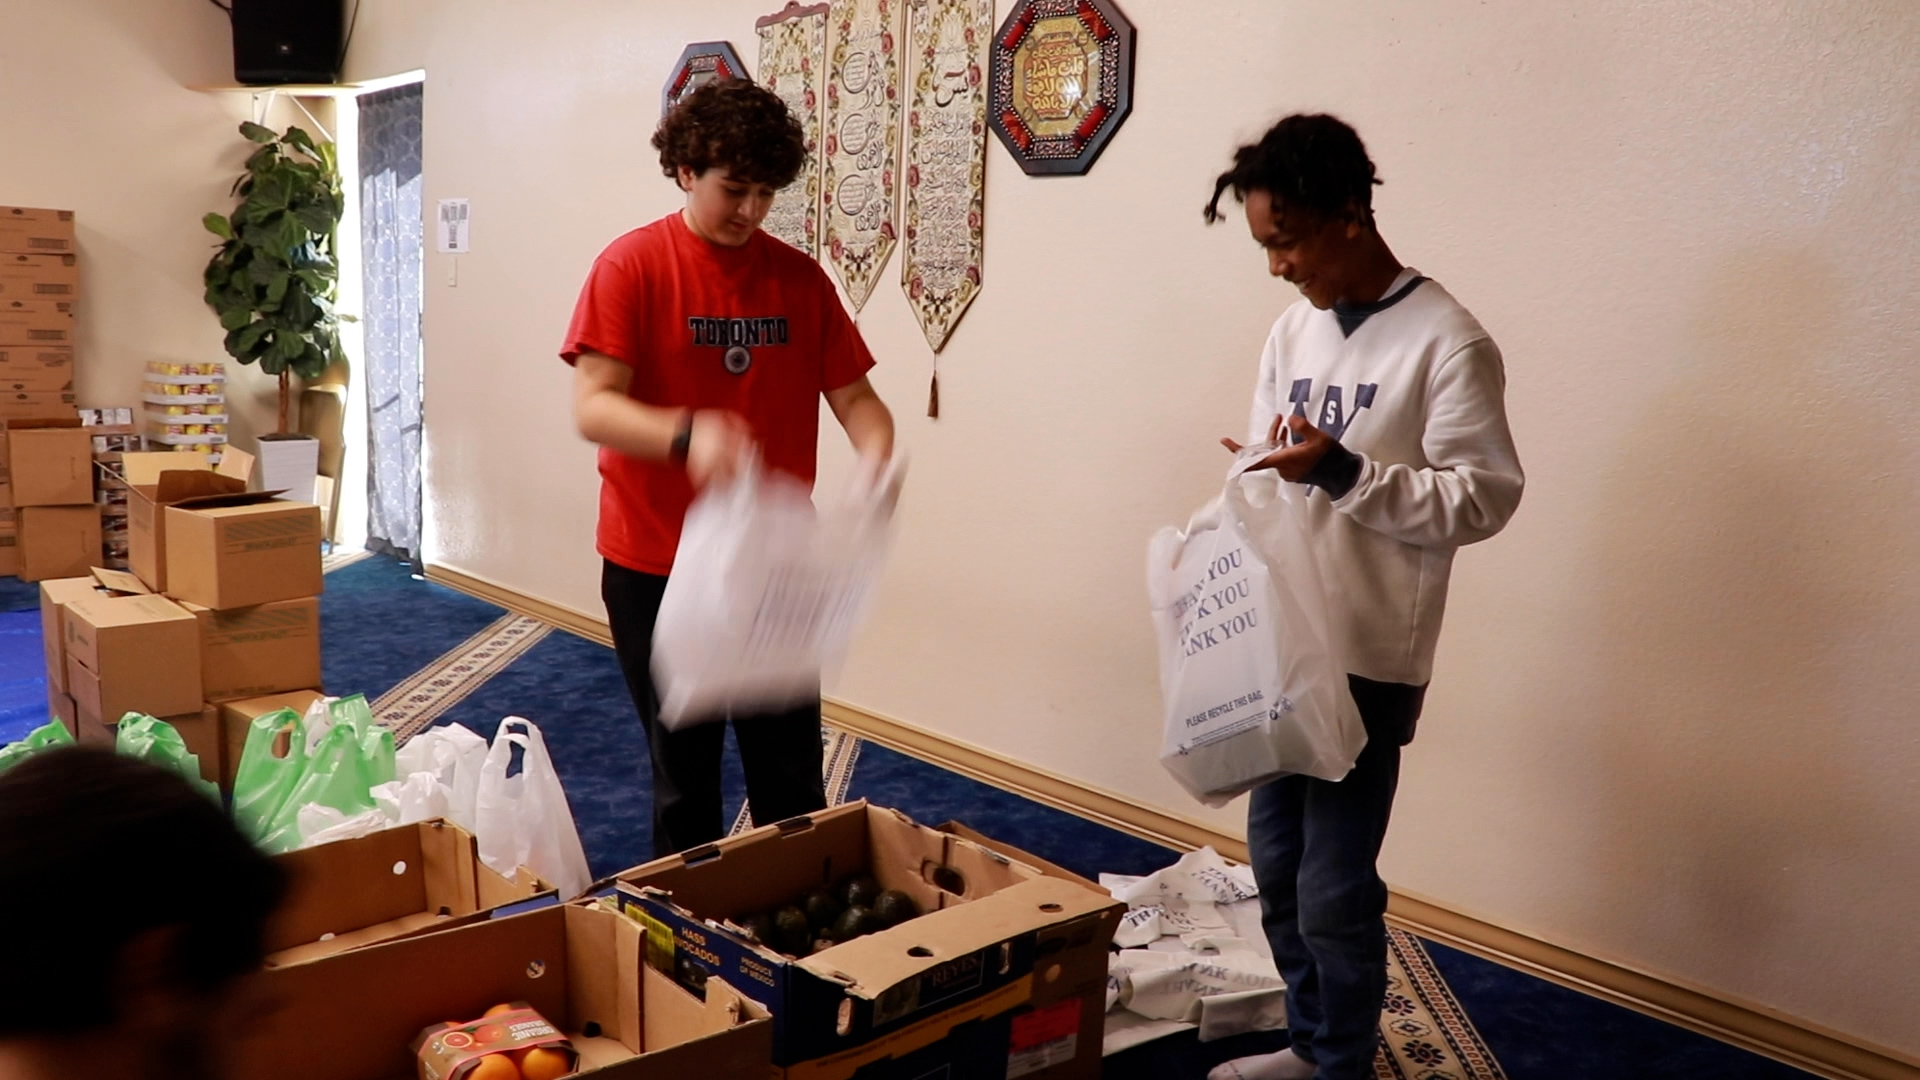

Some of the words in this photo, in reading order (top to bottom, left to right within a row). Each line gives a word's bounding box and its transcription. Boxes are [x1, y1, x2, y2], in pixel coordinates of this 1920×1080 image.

[688, 316, 788, 347] TORONTO
[1208, 548, 1243, 581] YOU
[1211, 578, 1250, 611] YOU
[1218, 608, 1257, 640] YOU
[1185, 711, 1208, 728] PLEASE
[1207, 701, 1234, 720] RECYCLE
[1233, 695, 1248, 710] THIS
[681, 926, 706, 946] HASS
[741, 956, 772, 977] PRODUCE
[749, 969, 775, 987] MEXICO
